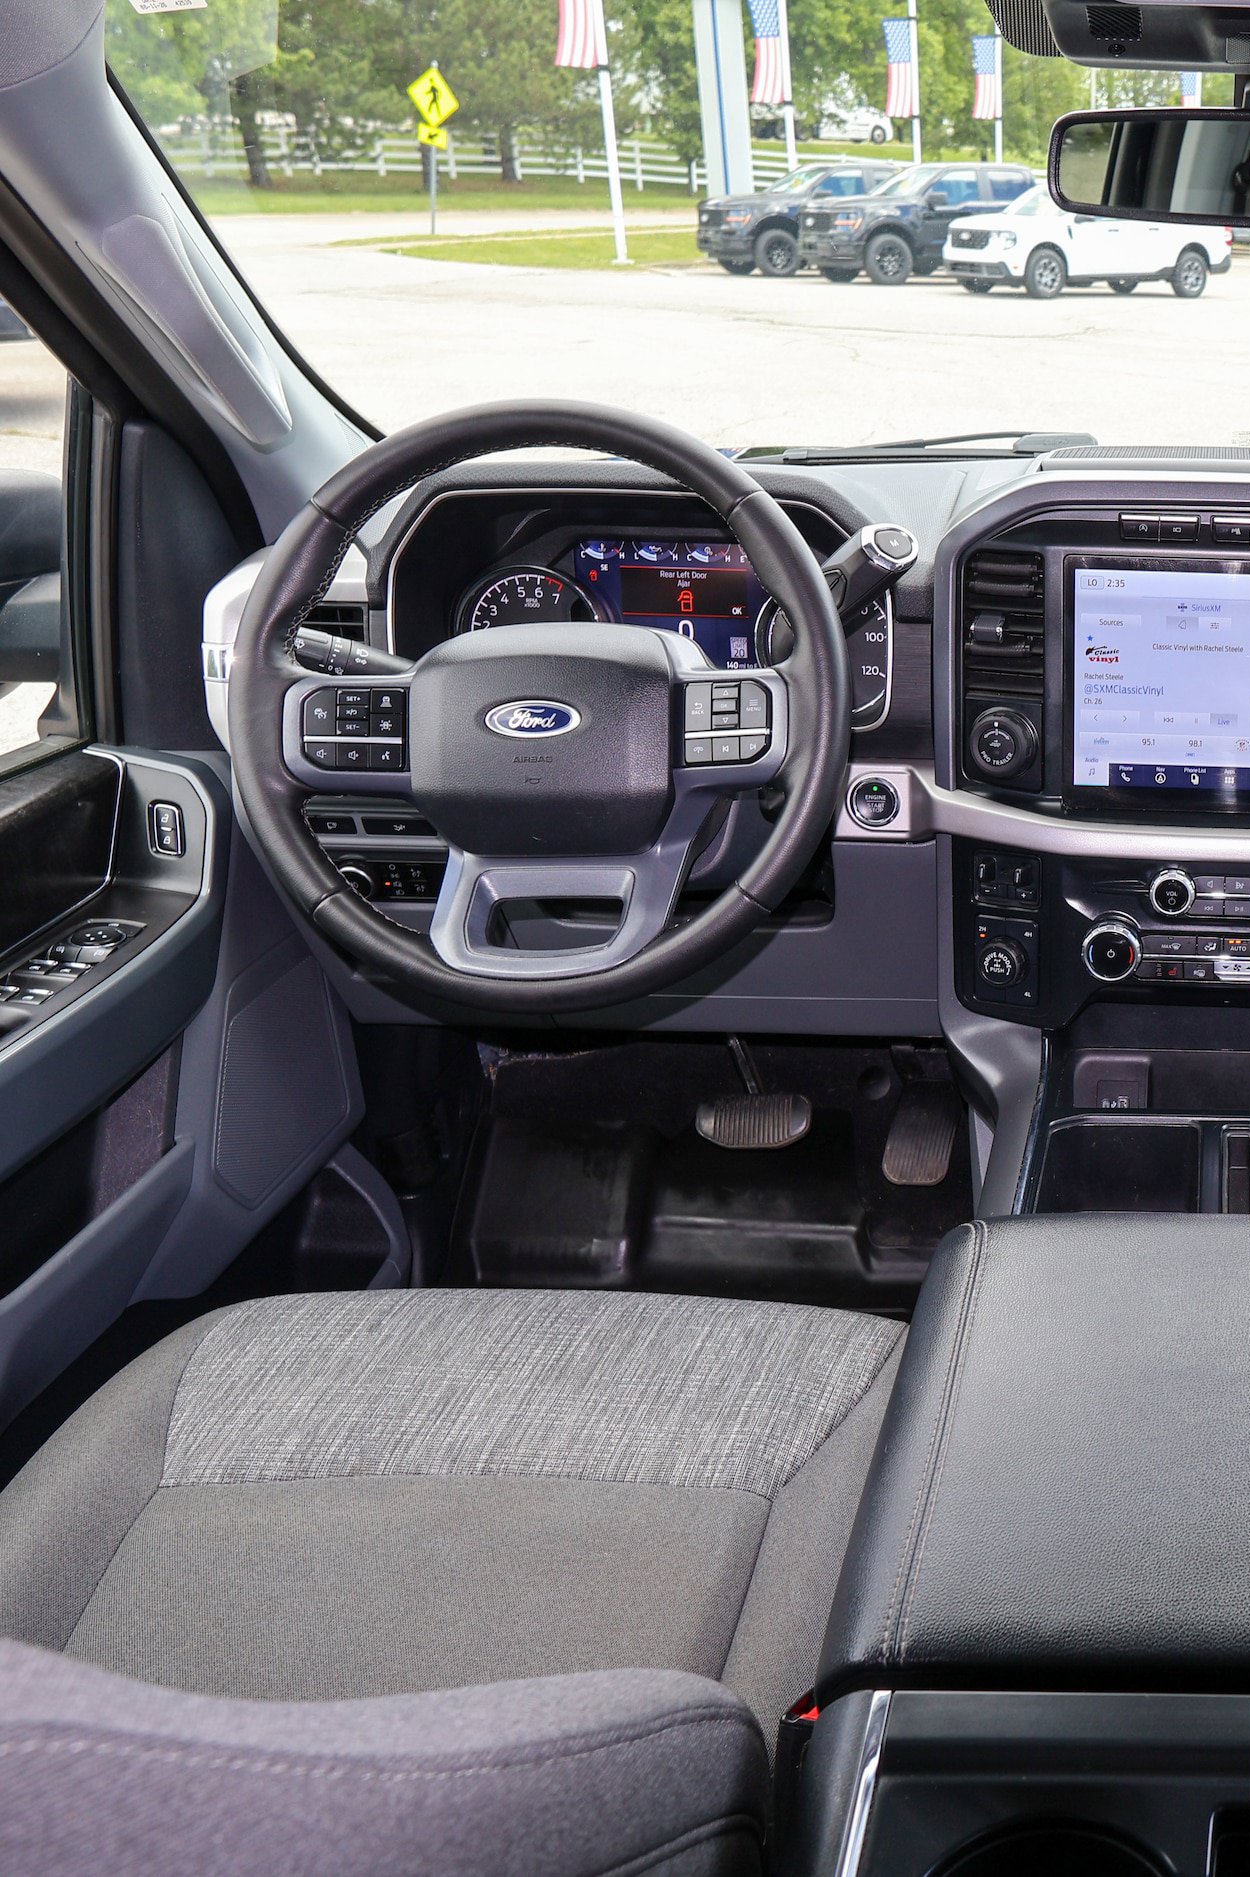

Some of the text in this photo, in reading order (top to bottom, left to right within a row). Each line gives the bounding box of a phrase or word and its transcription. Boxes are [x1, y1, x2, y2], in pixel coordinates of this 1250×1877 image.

[890, 539, 899, 547] M
[581, 550, 586, 558] C
[634, 552, 639, 560] L
[672, 553, 678, 561] H
[686, 553, 692, 561] C
[660, 570, 707, 579] Rear Left Door
[677, 580, 691, 588] Ajar
[1087, 578, 1098, 587] LO
[1107, 579, 1125, 588] 2:35
[517, 586, 526, 598] 5
[534, 587, 543, 598] 6
[501, 593, 509, 604] 4
[552, 593, 560, 605] 7
[489, 605, 498, 616] 3
[731, 607, 743, 615] OK
[1191, 603, 1221, 612] SiriusXM
[1099, 618, 1124, 627] Sources
[864, 632, 885, 642] 100
[1094, 648, 1120, 656] Classic
[1174, 643, 1188, 652] Vinyl
[1224, 645, 1244, 653] Steele
[734, 648, 745, 658] 20
[726, 661, 739, 669] 140
[861, 665, 880, 676] 120
[1084, 672, 1124, 681] Rachel Steele
[1084, 684, 1164, 697] @SXMClassicVinyl
[508, 708, 557, 729] Ford
[1218, 718, 1230, 726] Live
[1142, 738, 1156, 747] 95.1
[1188, 740, 1203, 748] 98.1
[980, 751, 1014, 766] PRO TRAILER
[983, 952, 1012, 968] DRIVE MODE
